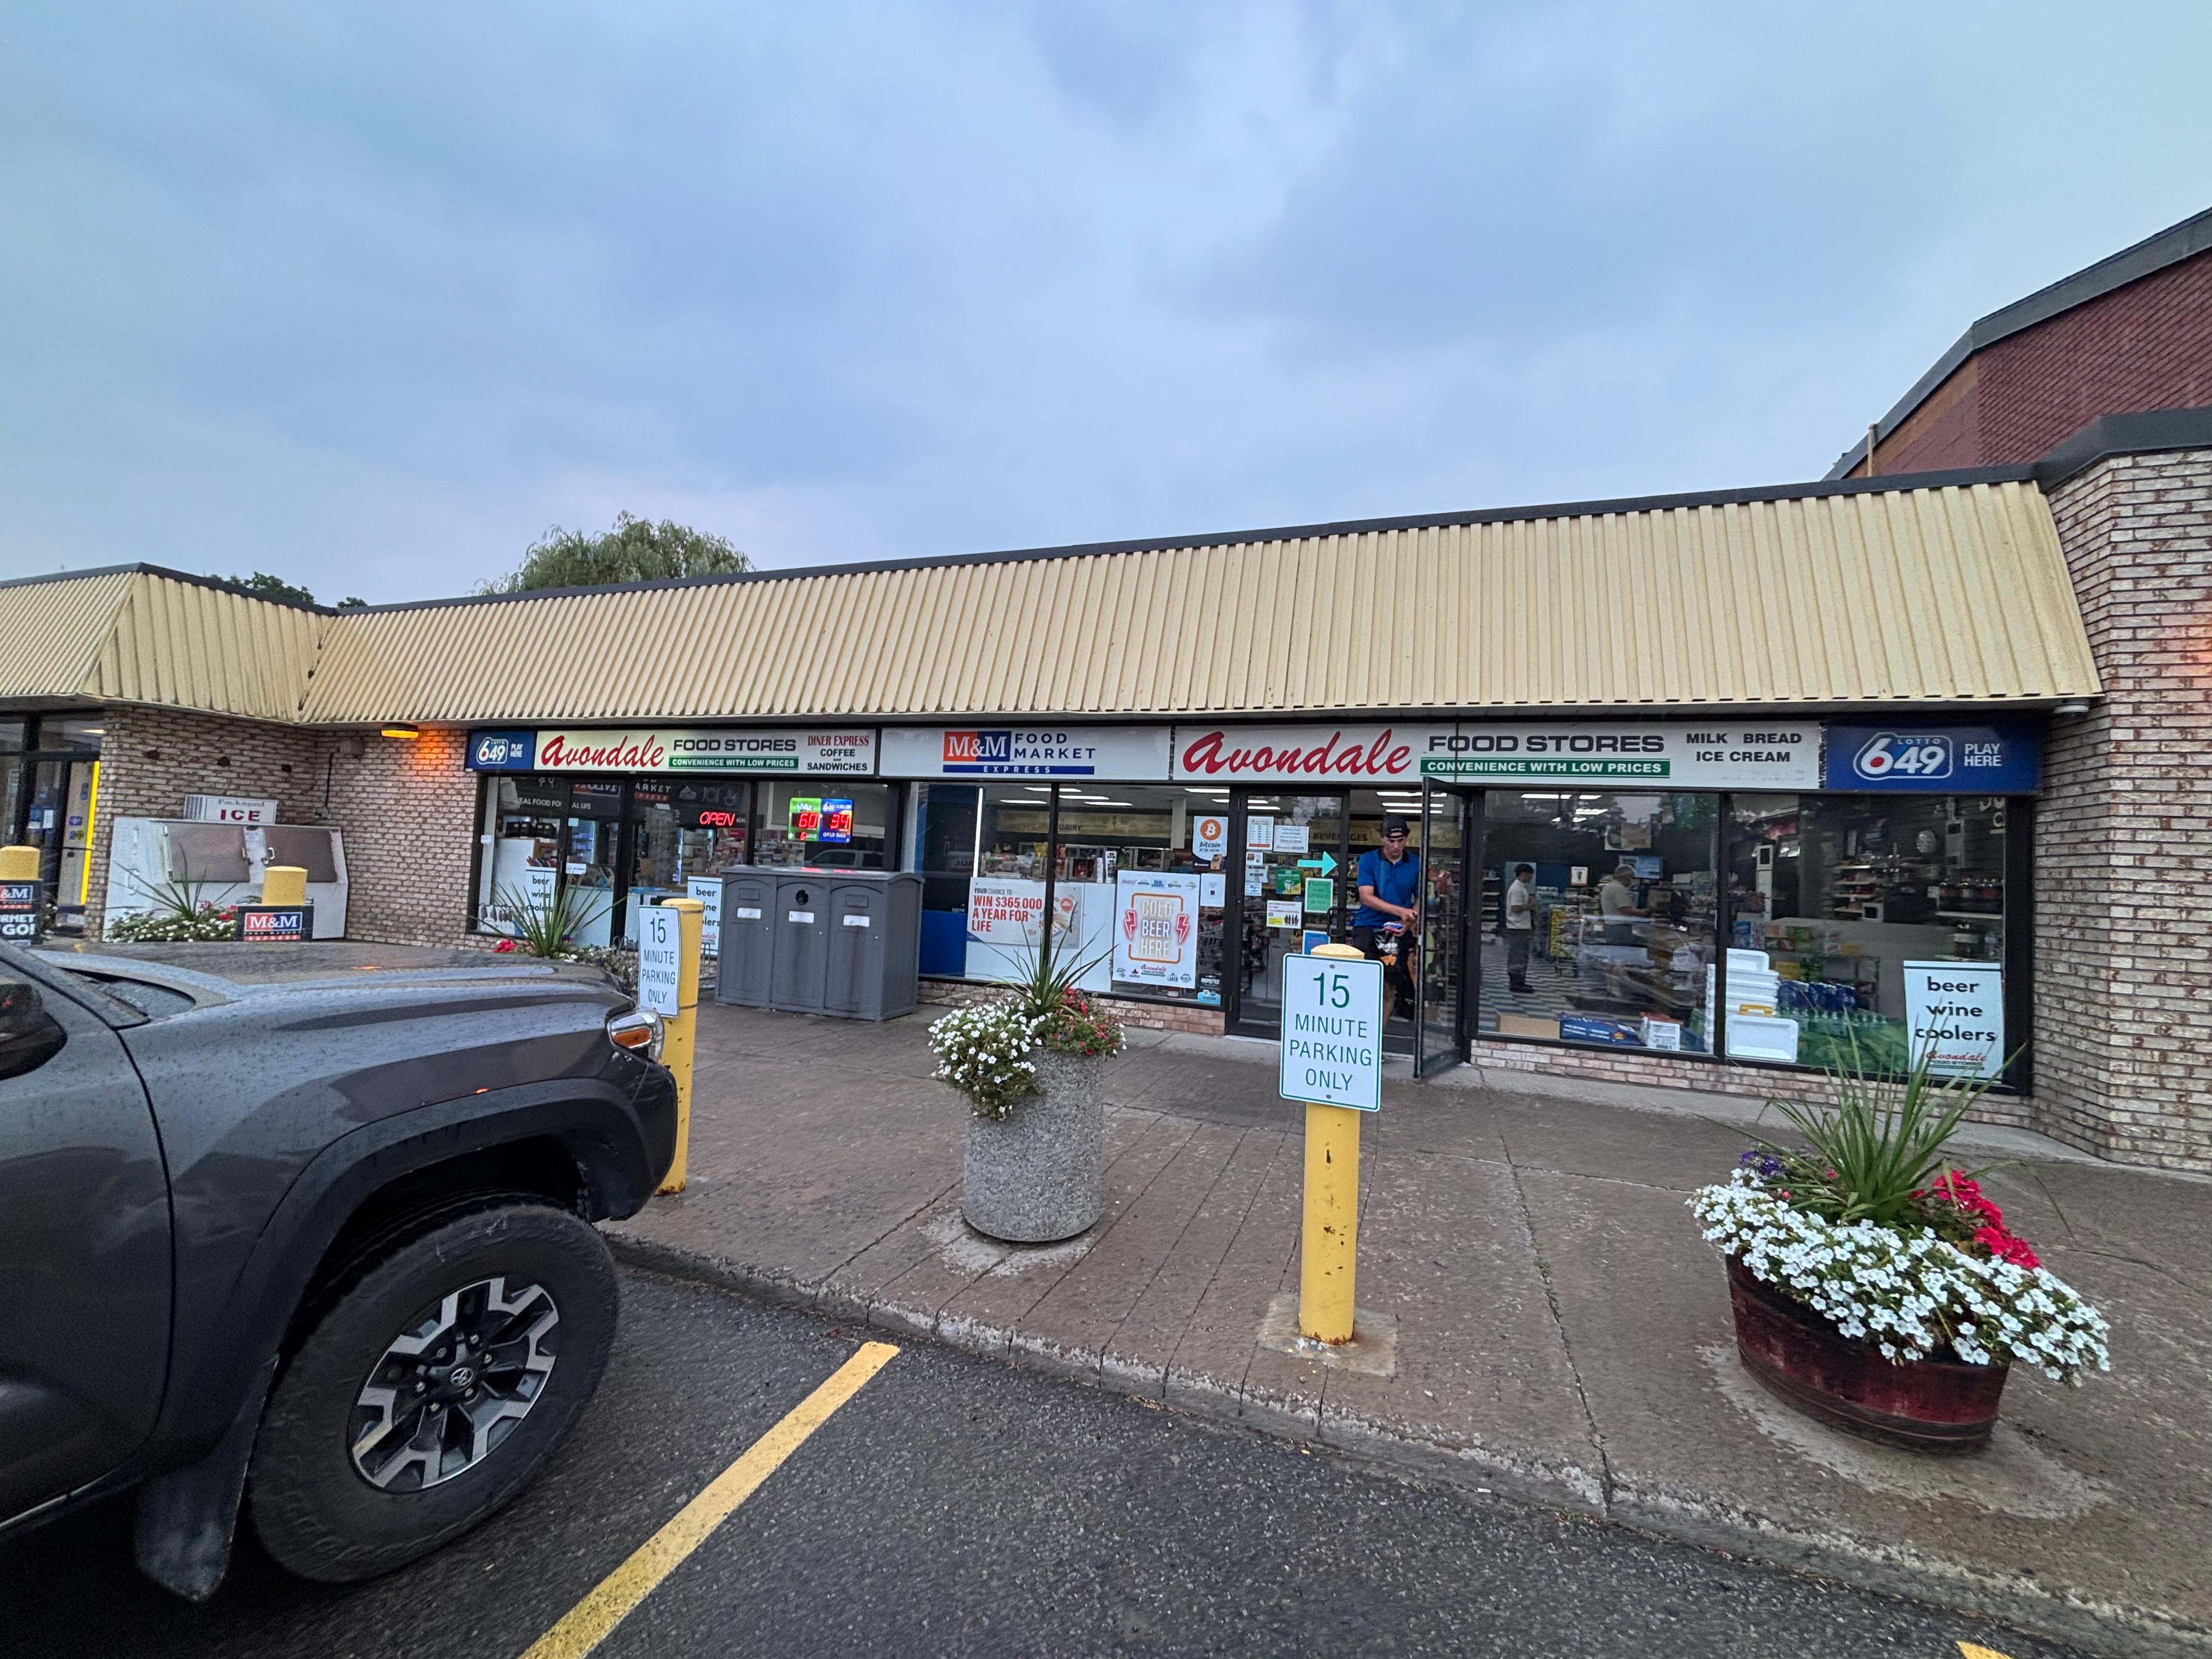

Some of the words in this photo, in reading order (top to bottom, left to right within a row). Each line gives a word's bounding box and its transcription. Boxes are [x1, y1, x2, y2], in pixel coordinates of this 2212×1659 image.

[808, 736, 831, 746] DINER
[834, 736, 869, 746] EXPRESS
[1015, 733, 1067, 743] FOOD
[1429, 736, 1518, 752] FOOD
[1526, 736, 1664, 752] STORES
[1686, 733, 1728, 743] MILK
[1743, 733, 1802, 743] BREAD
[479, 740, 506, 761] 649
[541, 734, 664, 768] Avondale
[674, 740, 720, 751] FOOD
[724, 739, 797, 752] STORES
[820, 748, 855, 757] COFFEE
[947, 736, 1007, 757] M&M
[1183, 729, 1412, 775] Avondale
[1965, 743, 2000, 754] PLAY
[1014, 748, 1096, 759] MARKET
[1696, 752, 1724, 761] ICE
[1729, 752, 1790, 762] CREAM
[1861, 738, 1945, 775] 649
[1963, 755, 2002, 766] HERE
[807, 763, 867, 771] SANDWICHES
[1427, 761, 1526, 772] CONVENIENCE
[1530, 763, 1567, 772] WITH
[1572, 763, 1603, 772] LOW
[1608, 763, 1661, 773] PRICES
[635, 782, 671, 792] ARKET
[797, 803, 812, 812] MAX
[221, 810, 261, 821] ICE
[699, 812, 735, 826] OPEN
[798, 812, 818, 828] 60
[831, 814, 849, 830] 34
[800, 832, 806, 841] 6
[1313, 833, 1368, 841] BEVEGES
[533, 875, 550, 884] beer
[0, 888, 28, 899] &M
[696, 886, 716, 897] beer
[703, 901, 717, 911] ine
[974, 895, 992, 907] WIN
[996, 896, 1042, 910] $365,000
[1142, 900, 1172, 917] COLD
[0, 915, 36, 923] RMET
[250, 916, 298, 928] M&M
[973, 908, 979, 918] A
[981, 908, 1007, 921] YEAR
[1009, 910, 1029, 922] FOR
[2, 924, 35, 935] GO!
[650, 917, 666, 944] 15
[972, 919, 991, 932] LIFE
[1142, 920, 1170, 938] BEER
[1141, 939, 1170, 957] HERE
[644, 950, 674, 964] MINUTE
[642, 969, 675, 985] PARKING
[1927, 976, 1980, 992] beer
[648, 989, 667, 1004] ONLY
[1313, 973, 1350, 1008] 15
[1926, 1001, 1983, 1017] wine
[1295, 1014, 1367, 1038] MINUTE
[1915, 1025, 1996, 1041] coolers
[1290, 1040, 1372, 1066] PARKING
[1306, 1069, 1353, 1091] ONLY
